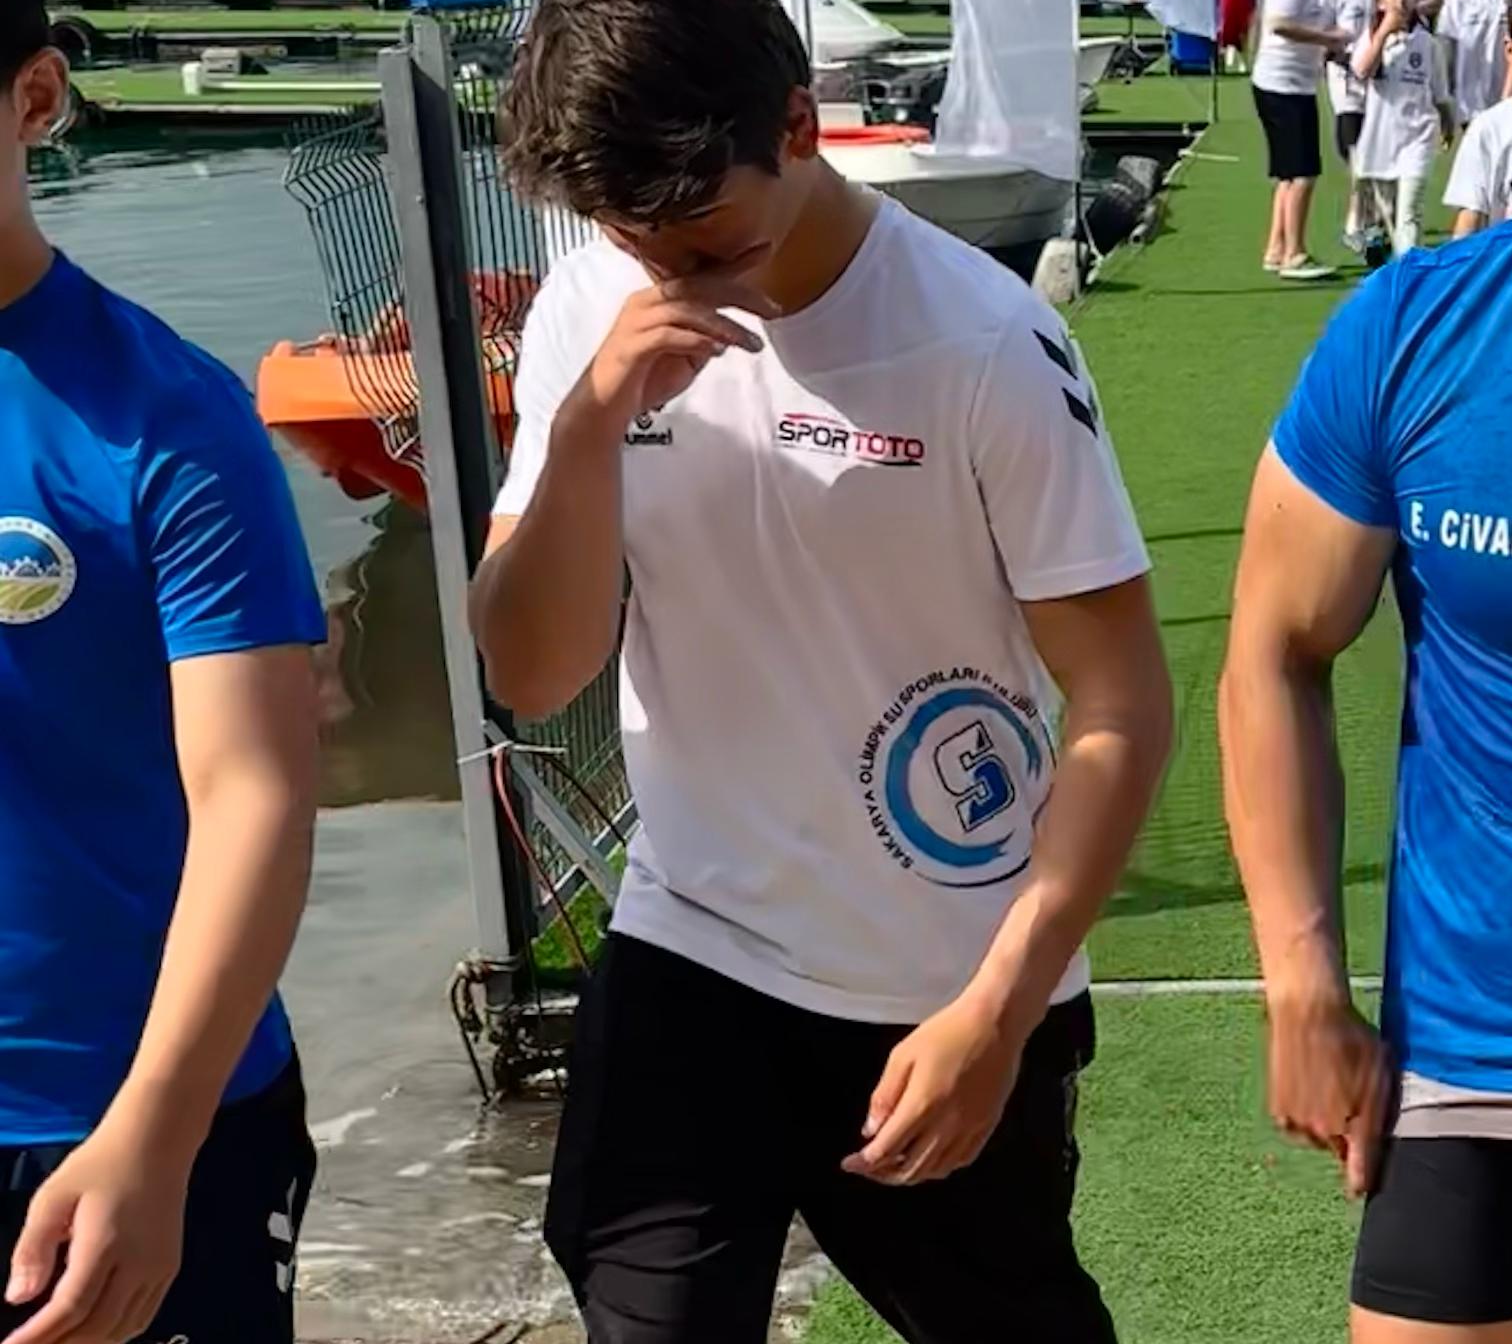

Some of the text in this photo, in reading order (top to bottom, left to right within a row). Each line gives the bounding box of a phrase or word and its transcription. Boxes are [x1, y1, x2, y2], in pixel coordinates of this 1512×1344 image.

[624, 427, 673, 447] ummel
[1410, 500, 1431, 541] E.
[900, 666, 981, 706] SPORLARI
[883, 703, 905, 725] SU
[863, 789, 913, 869] SAKARYA
